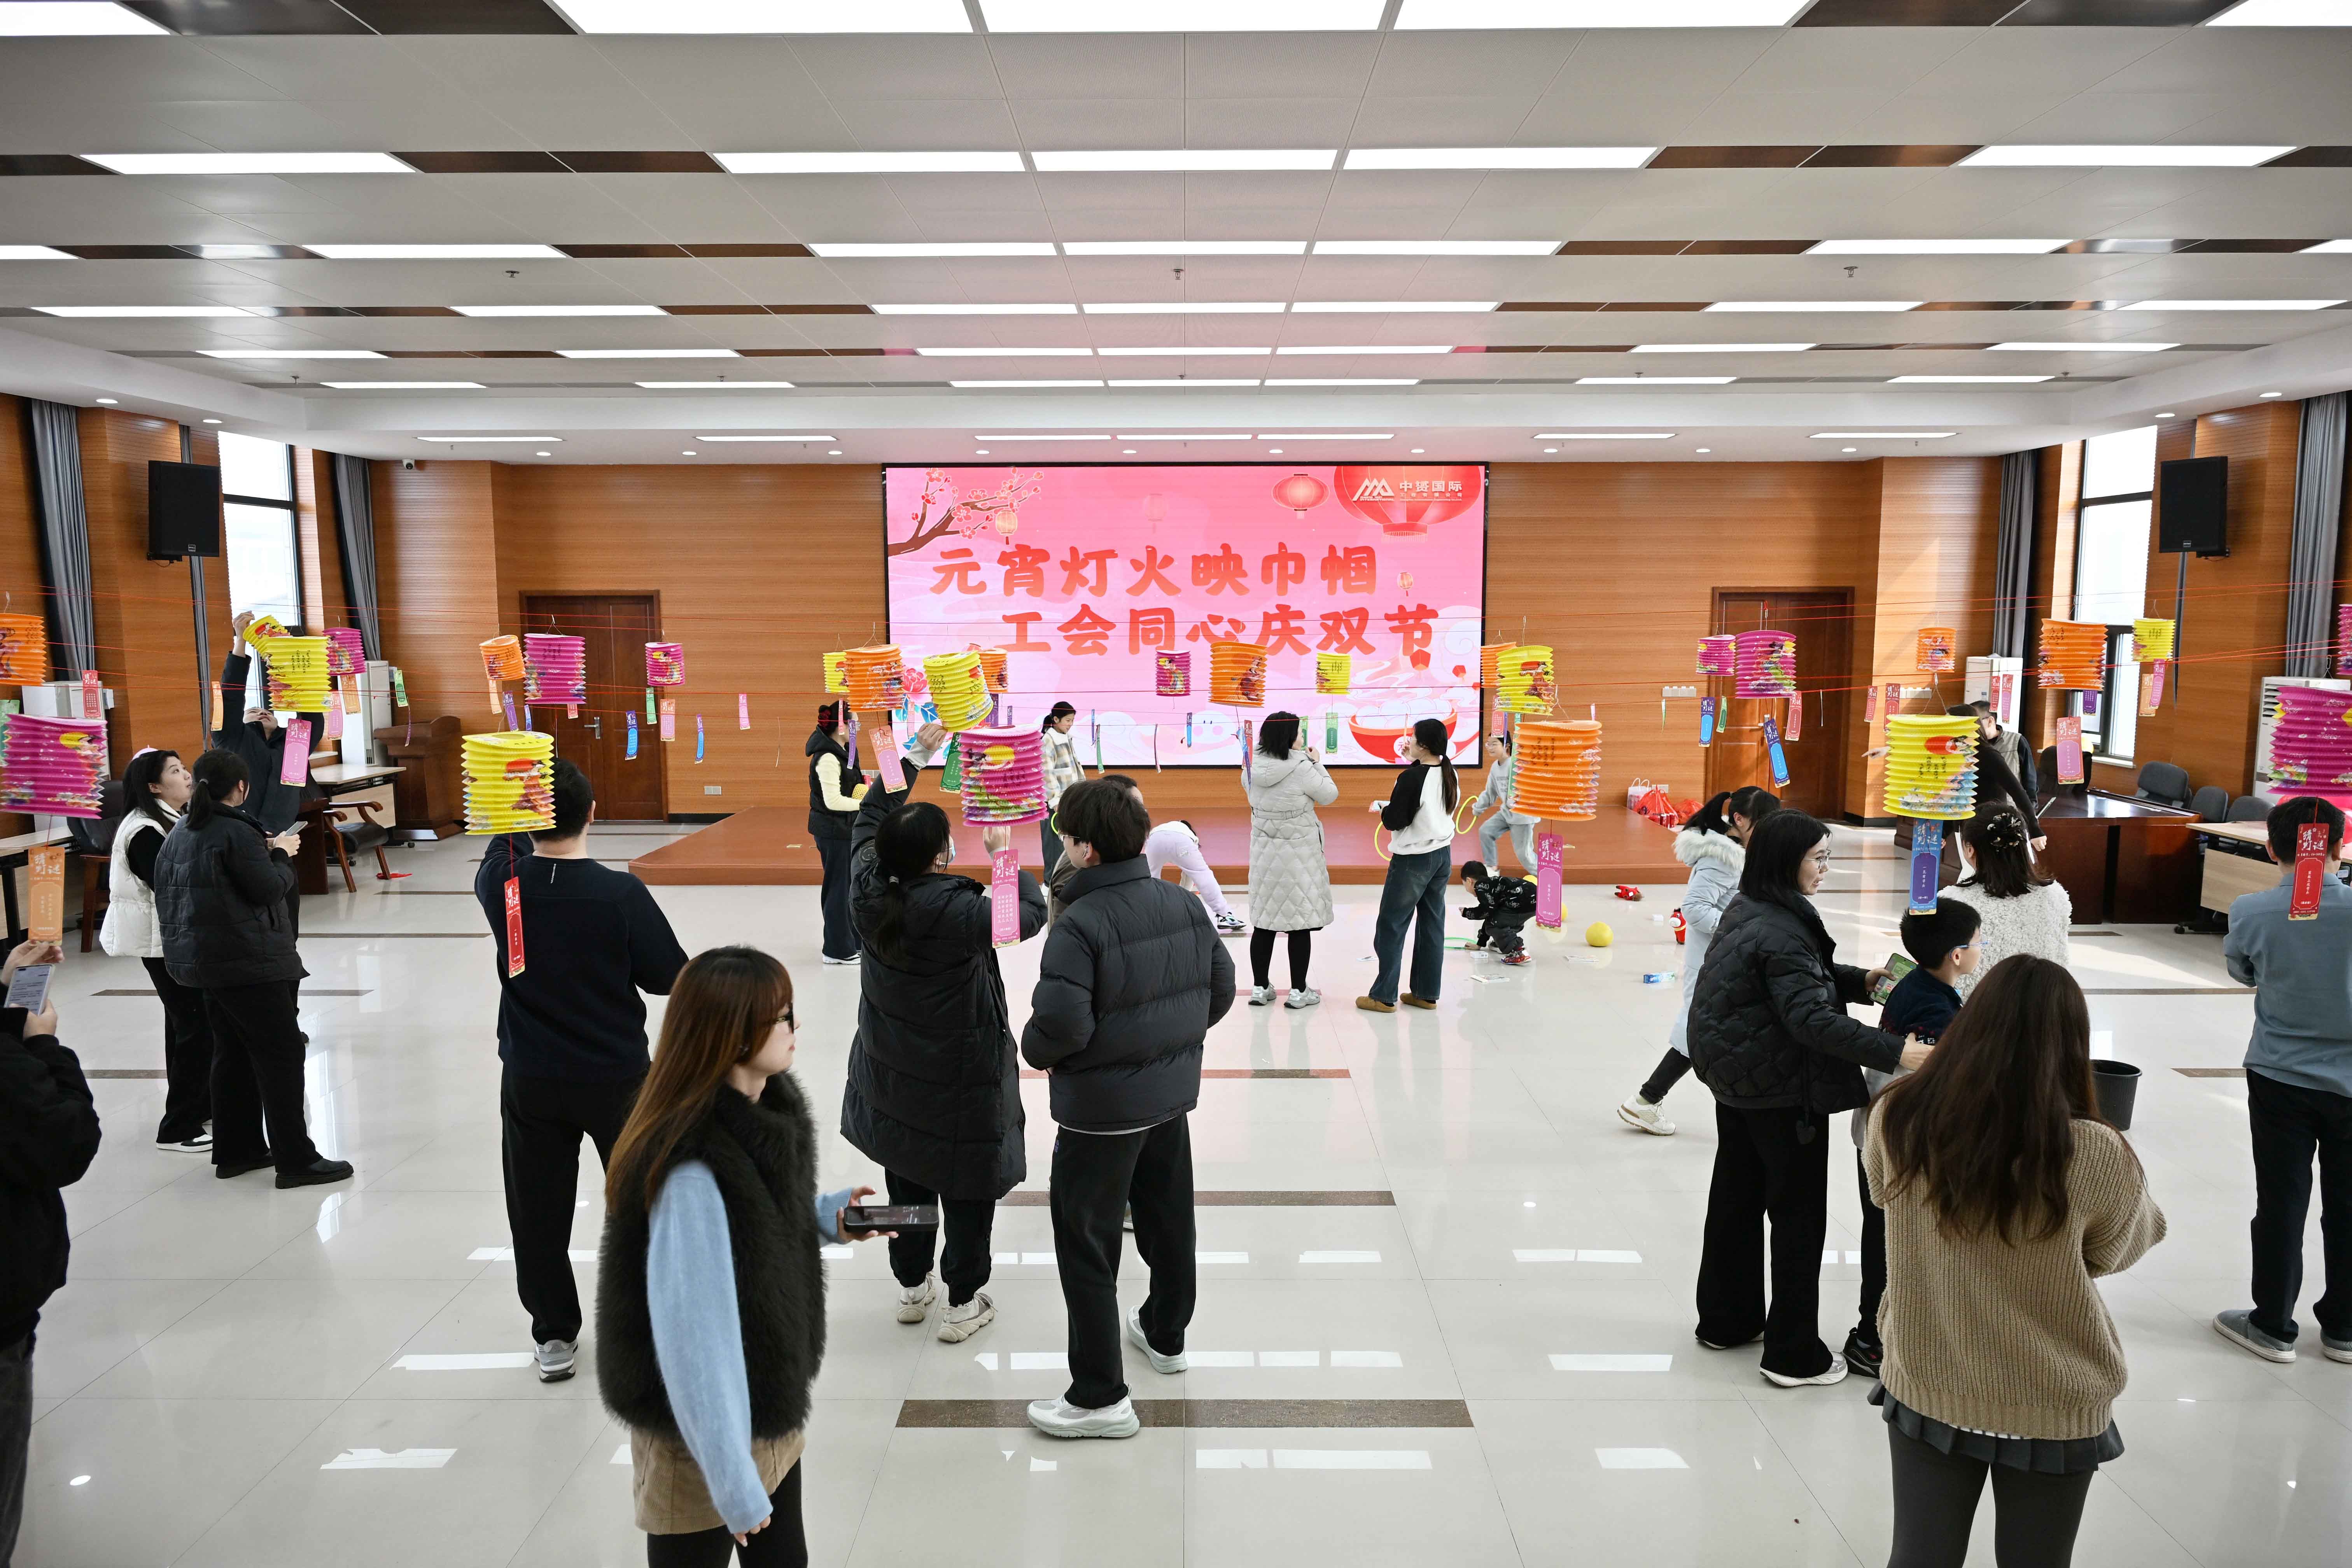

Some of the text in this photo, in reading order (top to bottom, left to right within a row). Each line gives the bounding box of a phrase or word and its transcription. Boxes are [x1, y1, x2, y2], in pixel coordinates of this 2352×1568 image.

[930, 541, 1377, 598] 元宵灯火映巾帼
[1000, 603, 1440, 657] 工会同心庆双节
[1541, 840, 1561, 862] 猜灯谜
[2301, 830, 2324, 851] 猜灯谜
[995, 857, 1016, 878] 猜灯谜
